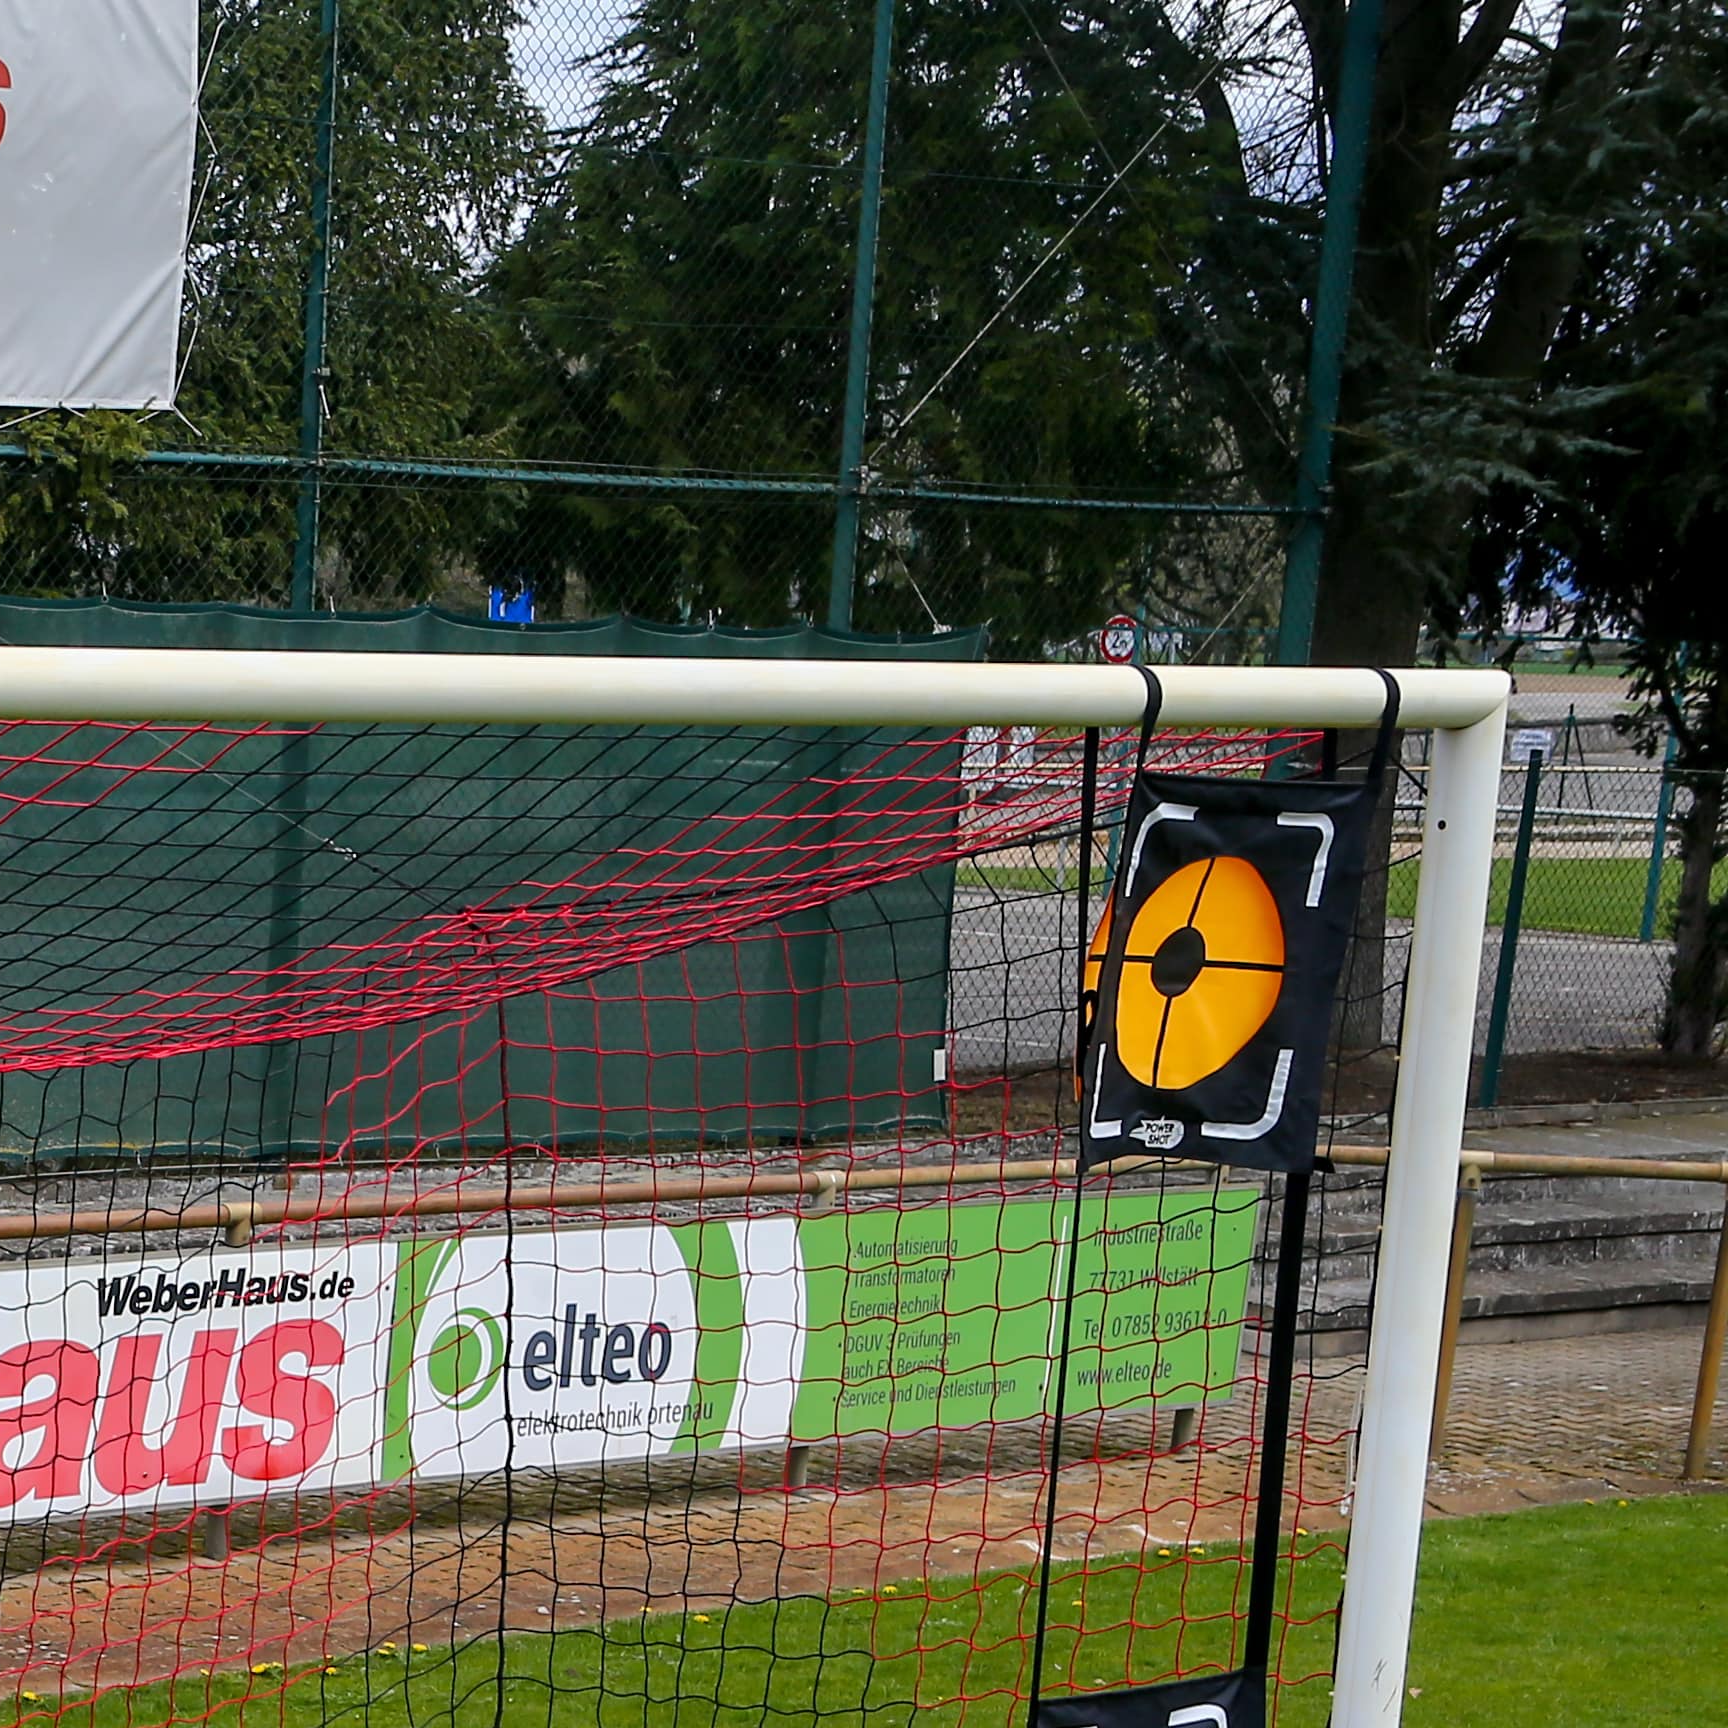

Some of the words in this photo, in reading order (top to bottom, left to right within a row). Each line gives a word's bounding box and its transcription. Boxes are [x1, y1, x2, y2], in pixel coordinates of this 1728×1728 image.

[1145, 1122, 1175, 1133] POWER
[1147, 1134, 1172, 1145] SHOT
[97, 1267, 355, 1317] WeberHaus.de
[849, 1294, 941, 1318] Energieechnik
[523, 1303, 672, 1391] elteo
[517, 1403, 643, 1437] elektrotechnik
